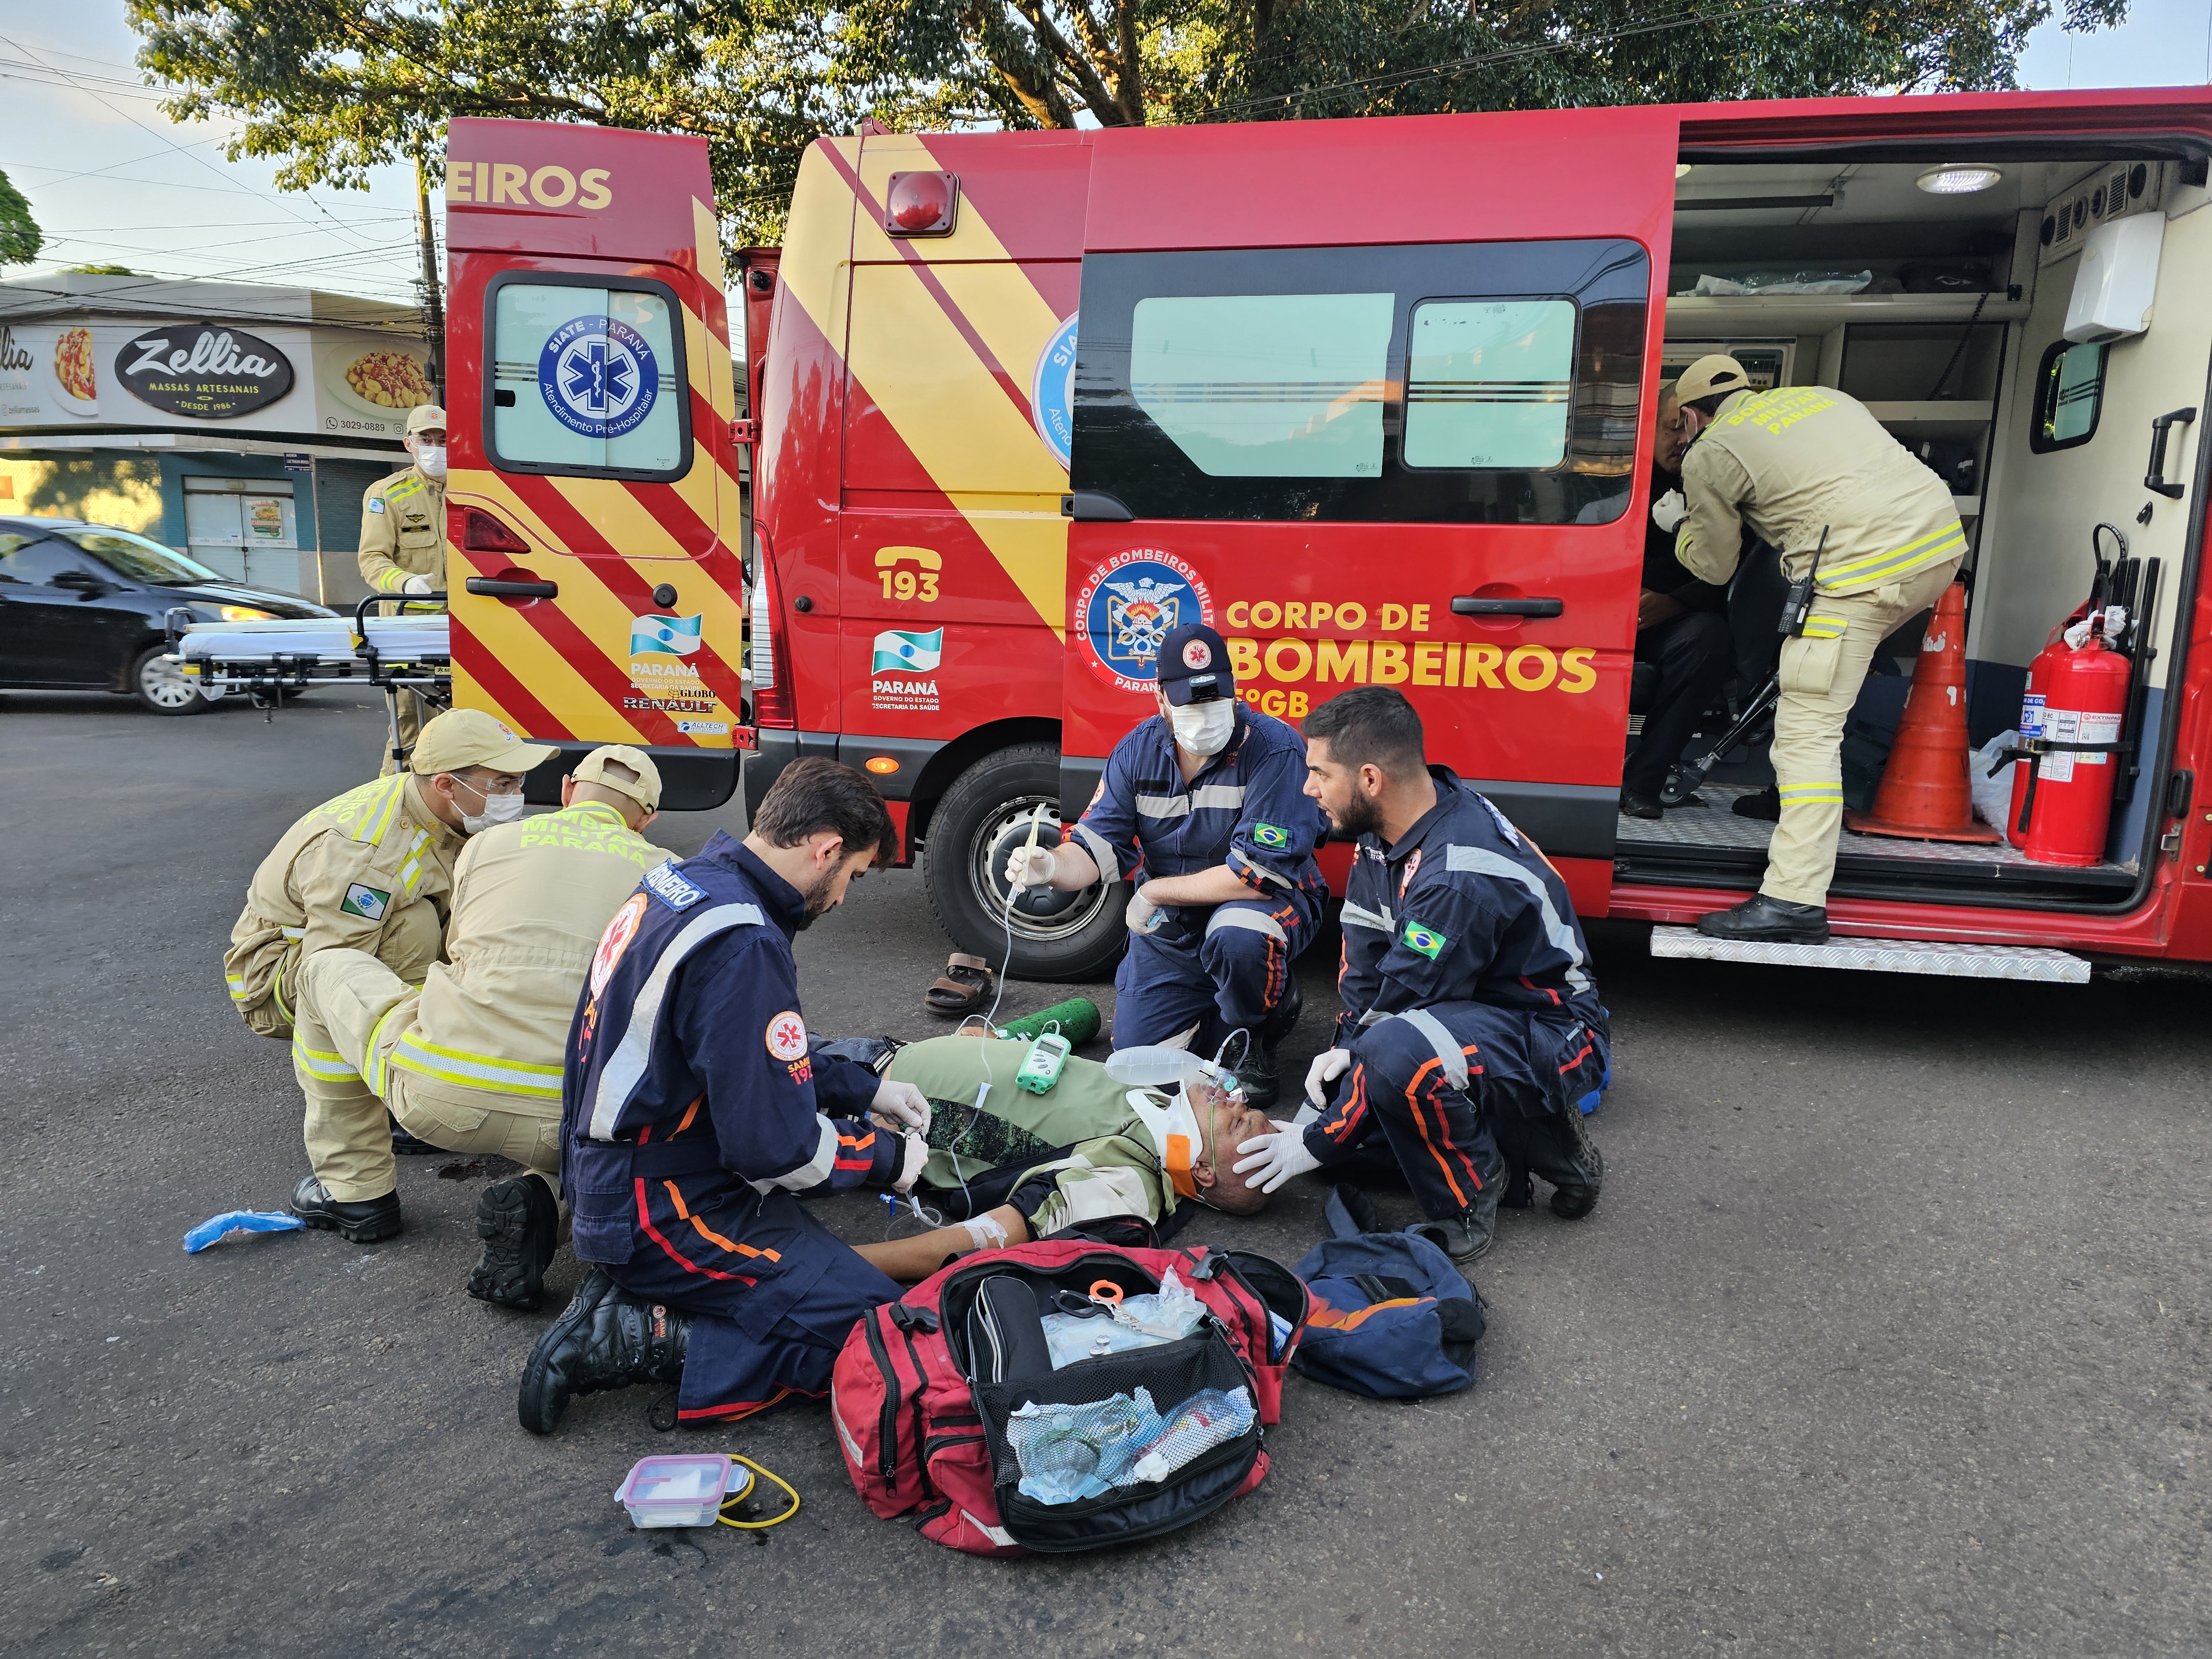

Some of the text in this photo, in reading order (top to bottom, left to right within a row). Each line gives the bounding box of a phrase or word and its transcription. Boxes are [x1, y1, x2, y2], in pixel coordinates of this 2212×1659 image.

[0, 325, 33, 371] lia
[125, 331, 277, 377] Zellia
[549, 321, 585, 353] SIATE
[599, 319, 650, 360] PARANÁ
[1053, 330, 1078, 367] SIA
[149, 383, 259, 394] MASSAS ARTESANAIS
[181, 400, 231, 411] DESDE 1986
[544, 382, 653, 434] Atendimento Pré-Hospitalar
[341, 420, 385, 431] 3029-0889
[879, 571, 939, 602] 193
[1075, 587, 1092, 641] CORPO
[1088, 564, 1108, 585] DE
[1109, 549, 1197, 581] BOMBEIROS
[1226, 601, 1430, 632] CORPO DE
[631, 662, 700, 677] PARANÁ
[1227, 637, 1597, 693] BOMBEIROS
[680, 689, 716, 698] GLOBO
[873, 680, 939, 696] PARANÁ
[1114, 676, 1161, 692] PARAN
[623, 697, 717, 713] RENAULT
[520, 834, 646, 869] PARANÁ
[787, 1056, 810, 1073] SAMU
